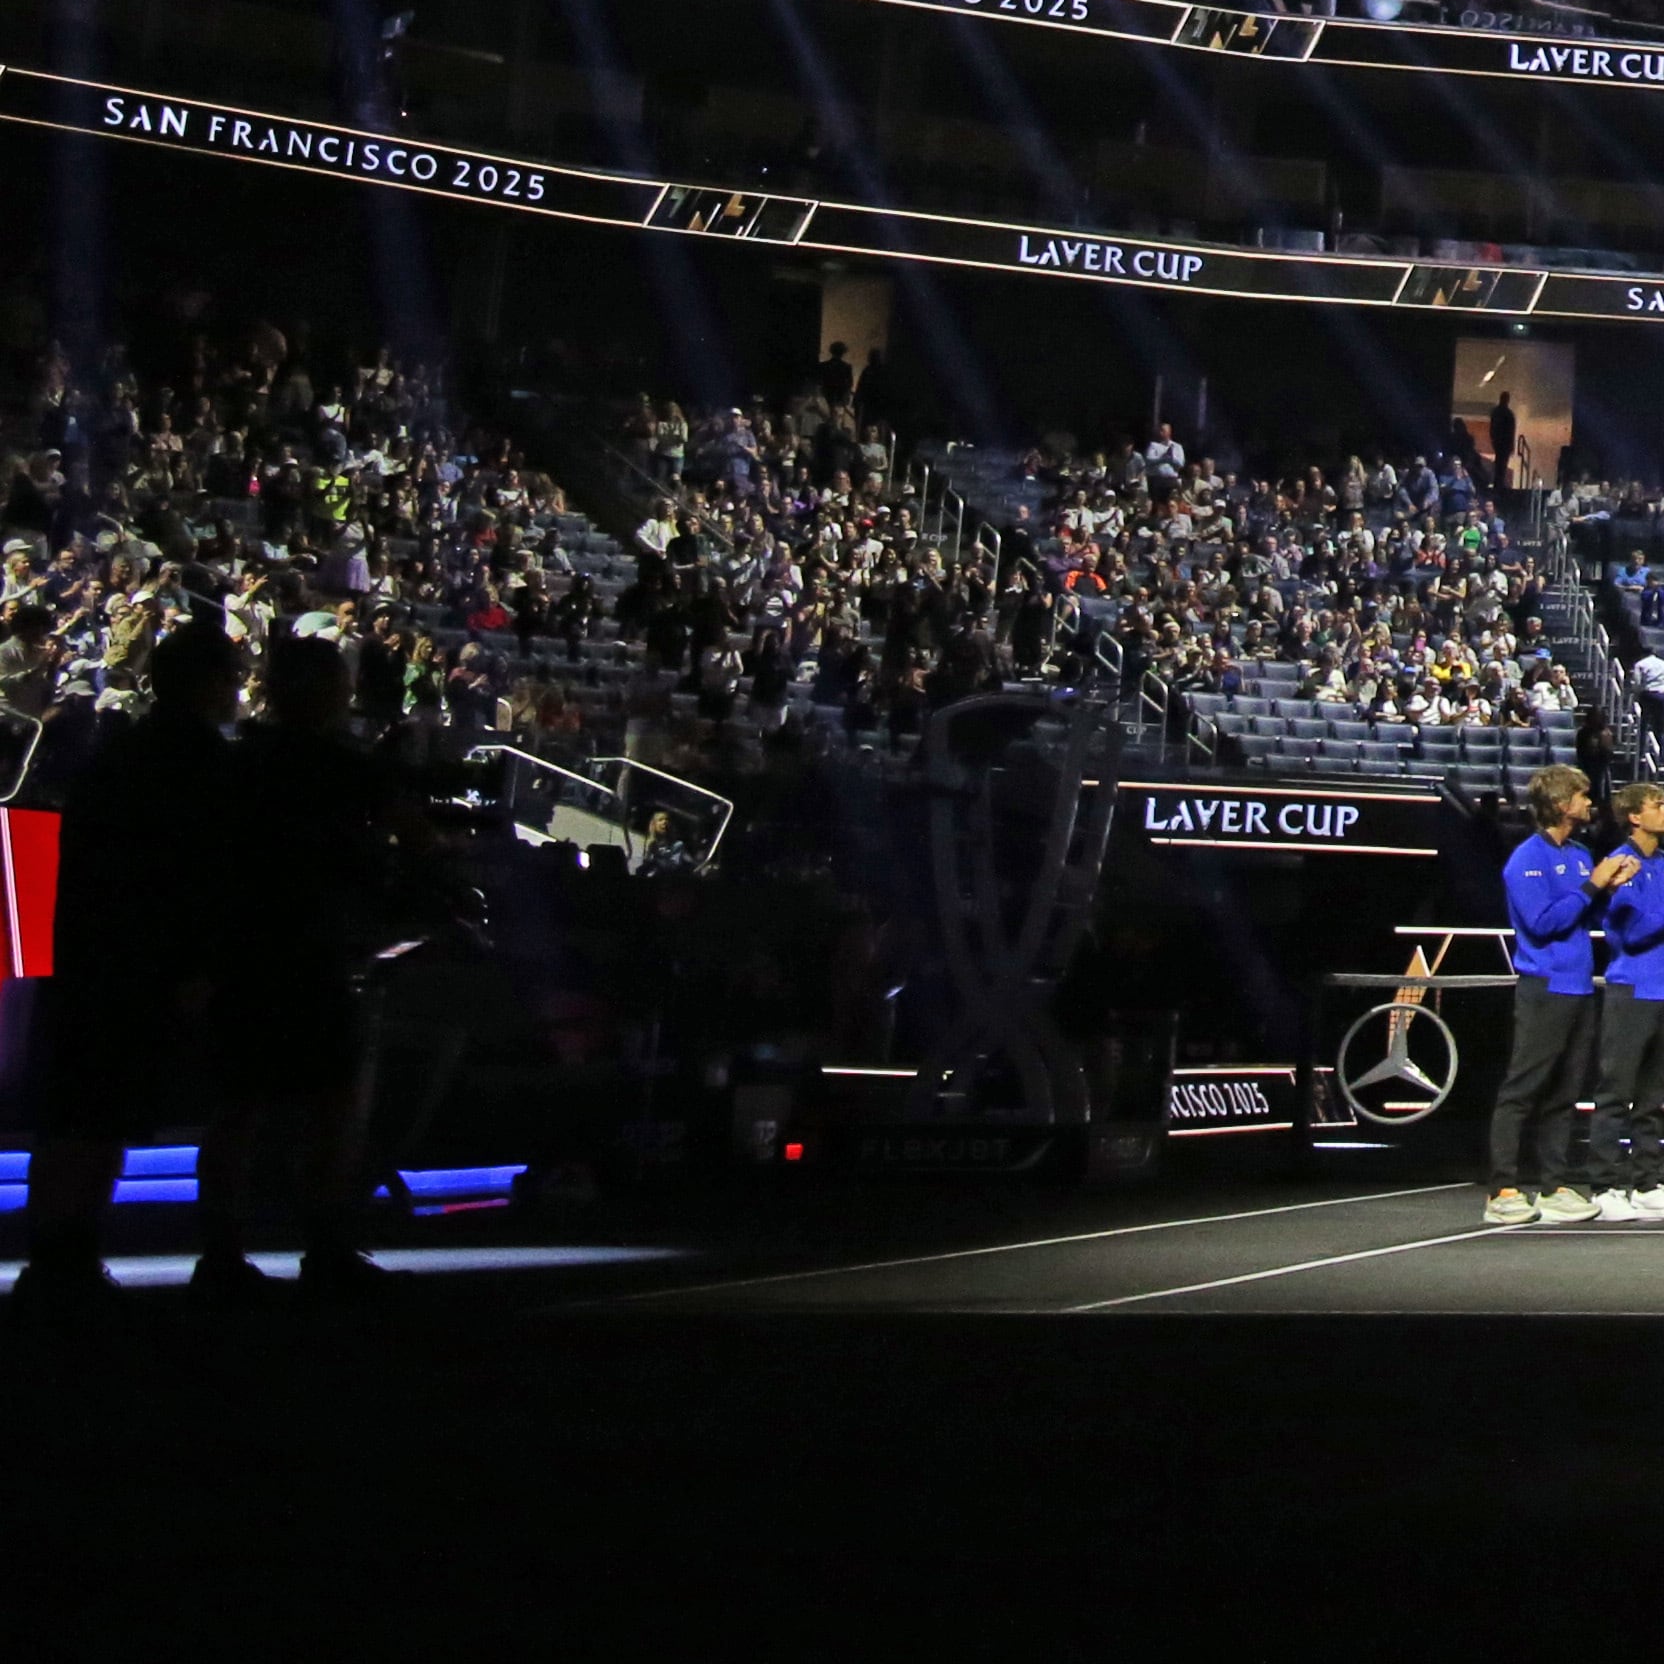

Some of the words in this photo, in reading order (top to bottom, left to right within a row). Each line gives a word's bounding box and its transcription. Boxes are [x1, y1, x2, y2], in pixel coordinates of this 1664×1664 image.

[1509, 43, 1615, 77] LAVER
[103, 97, 189, 137] SAN
[208, 115, 438, 180] FRANCISCO
[452, 160, 545, 200] 2025
[1018, 234, 1127, 275] LAVER
[1132, 250, 1203, 282] CUP
[1144, 796, 1271, 834] LAVER
[1277, 803, 1360, 838] CUP
[1170, 1084, 1228, 1118] CISCO
[1222, 1082, 1270, 1115] 2025
